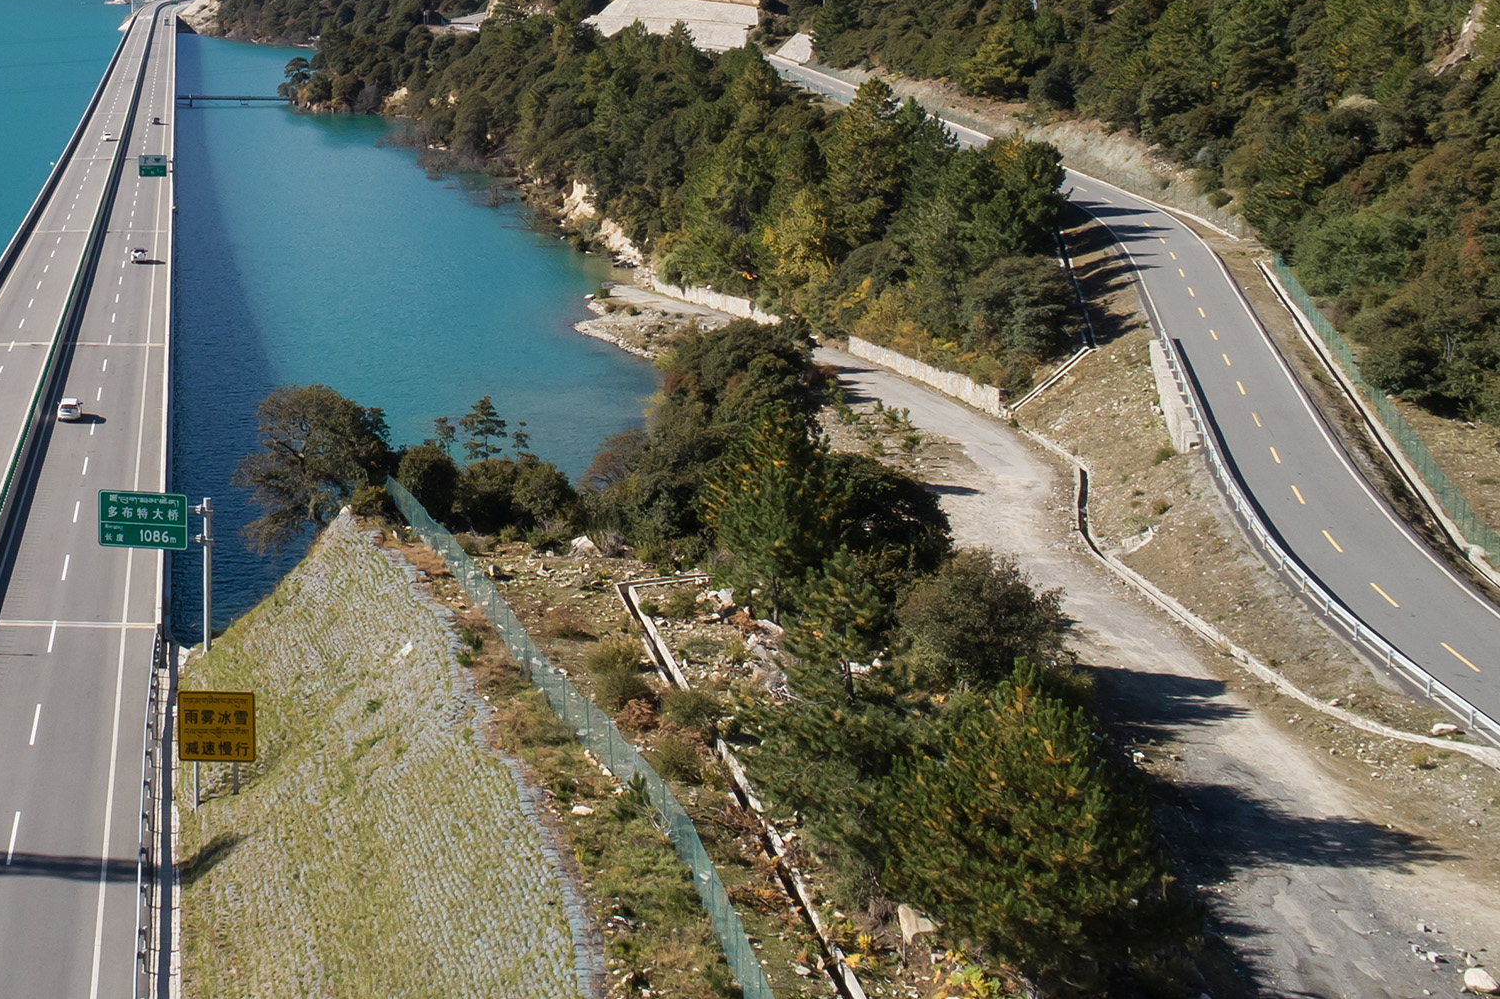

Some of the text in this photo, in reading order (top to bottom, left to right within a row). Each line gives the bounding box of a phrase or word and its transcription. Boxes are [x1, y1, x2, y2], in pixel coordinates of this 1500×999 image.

[108, 506, 179, 521] 多布特大桥
[105, 529, 176, 543] 长度 1086m
[184, 709, 248, 725] 雨雾冰雪
[185, 741, 249, 756] 减速慢行
